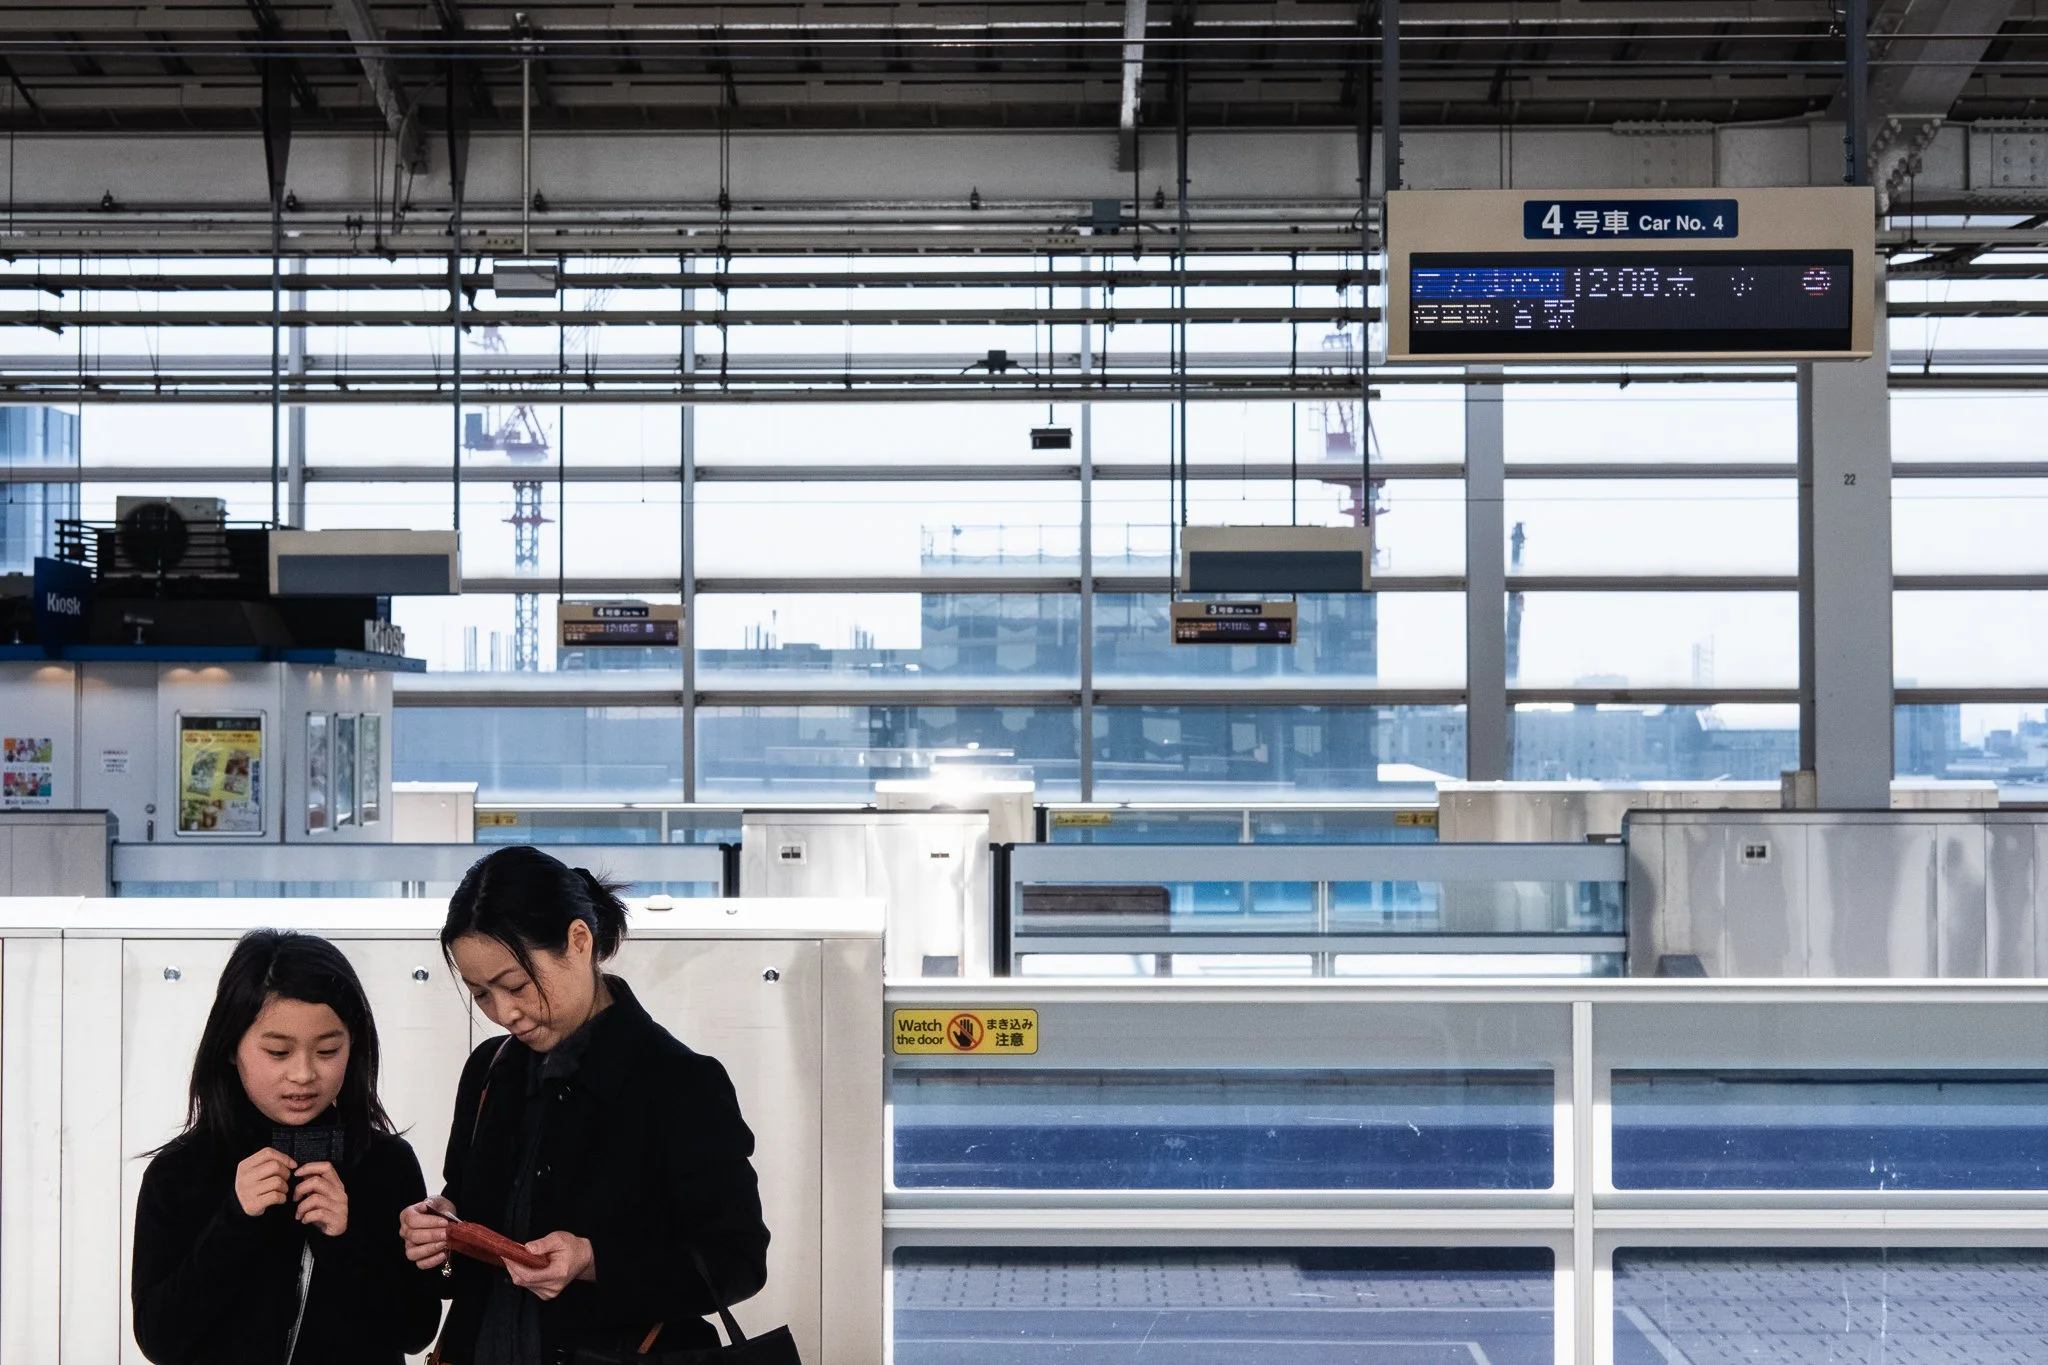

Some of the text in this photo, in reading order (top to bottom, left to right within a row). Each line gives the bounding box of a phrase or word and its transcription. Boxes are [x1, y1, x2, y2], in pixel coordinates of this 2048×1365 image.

[1541, 204, 1724, 236] 4号車 Car No. 4
[1844, 473, 1856, 485] 22
[47, 592, 81, 616] Kiosk
[364, 617, 405, 656] Kiosk
[898, 1018, 942, 1032] Watch
[986, 1018, 1034, 1030] まき込み
[896, 1034, 945, 1045] the door
[995, 1033, 1024, 1047] 注意
